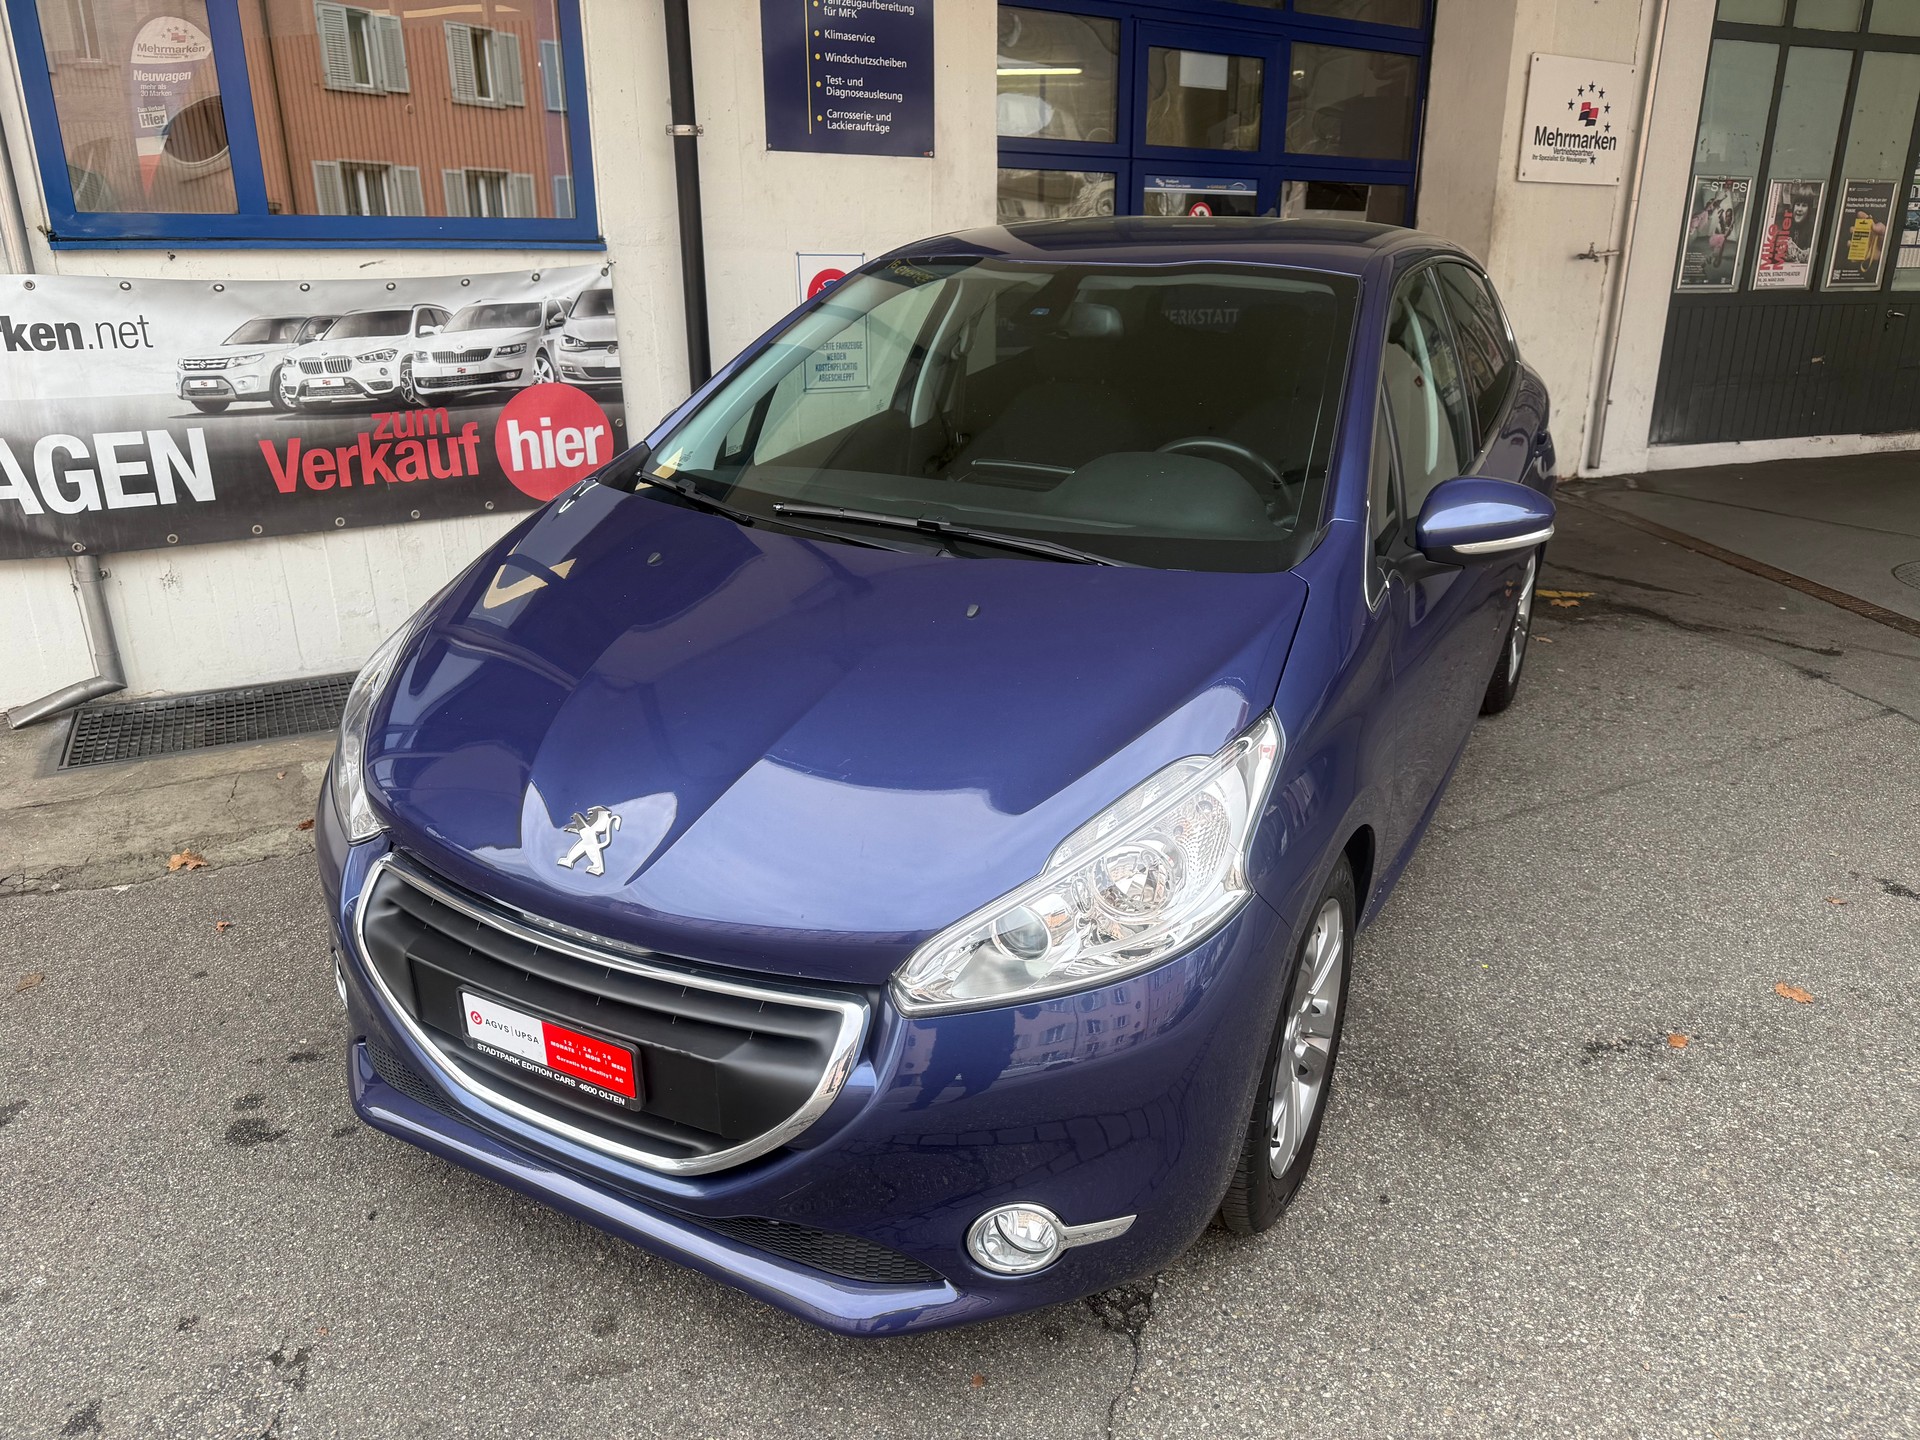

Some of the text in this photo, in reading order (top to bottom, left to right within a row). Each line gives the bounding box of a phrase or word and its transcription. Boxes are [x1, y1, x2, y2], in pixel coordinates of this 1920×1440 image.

[823, 6, 858, 19] für MFK
[824, 29, 876, 43] Klimaservice
[138, 43, 205, 53] Mehrmarken
[825, 53, 907, 68] Windschutzscheiben
[134, 70, 191, 83] Neuwagen
[825, 74, 864, 87] Test- und
[826, 86, 903, 103] Diagnoseauslesung
[141, 114, 165, 126] Hier
[826, 108, 892, 122] Carrosserie- und
[827, 120, 890, 135] Lackieraufträge
[1534, 126, 1616, 150] Mehrmarken
[1165, 309, 1239, 324] ERKSTATT
[0, 315, 153, 352] ken.net
[836, 342, 863, 350] FAHRZEUGE
[816, 363, 857, 371] KOSTENPFLICHTIG
[819, 373, 854, 382] ABGESCHLEPPT
[371, 407, 450, 440] zum
[258, 416, 605, 494] Verkauf hier
[485, 1019, 540, 1044] AGVS UPSA
[550, 1040, 575, 1054] MONATE
[585, 1053, 601, 1063] MOIS
[556, 1055, 580, 1067] Garantie
[580, 1063, 588, 1071] by
[477, 1043, 626, 1106] STADTPARK EDITION CARS 4600 OLTEN
